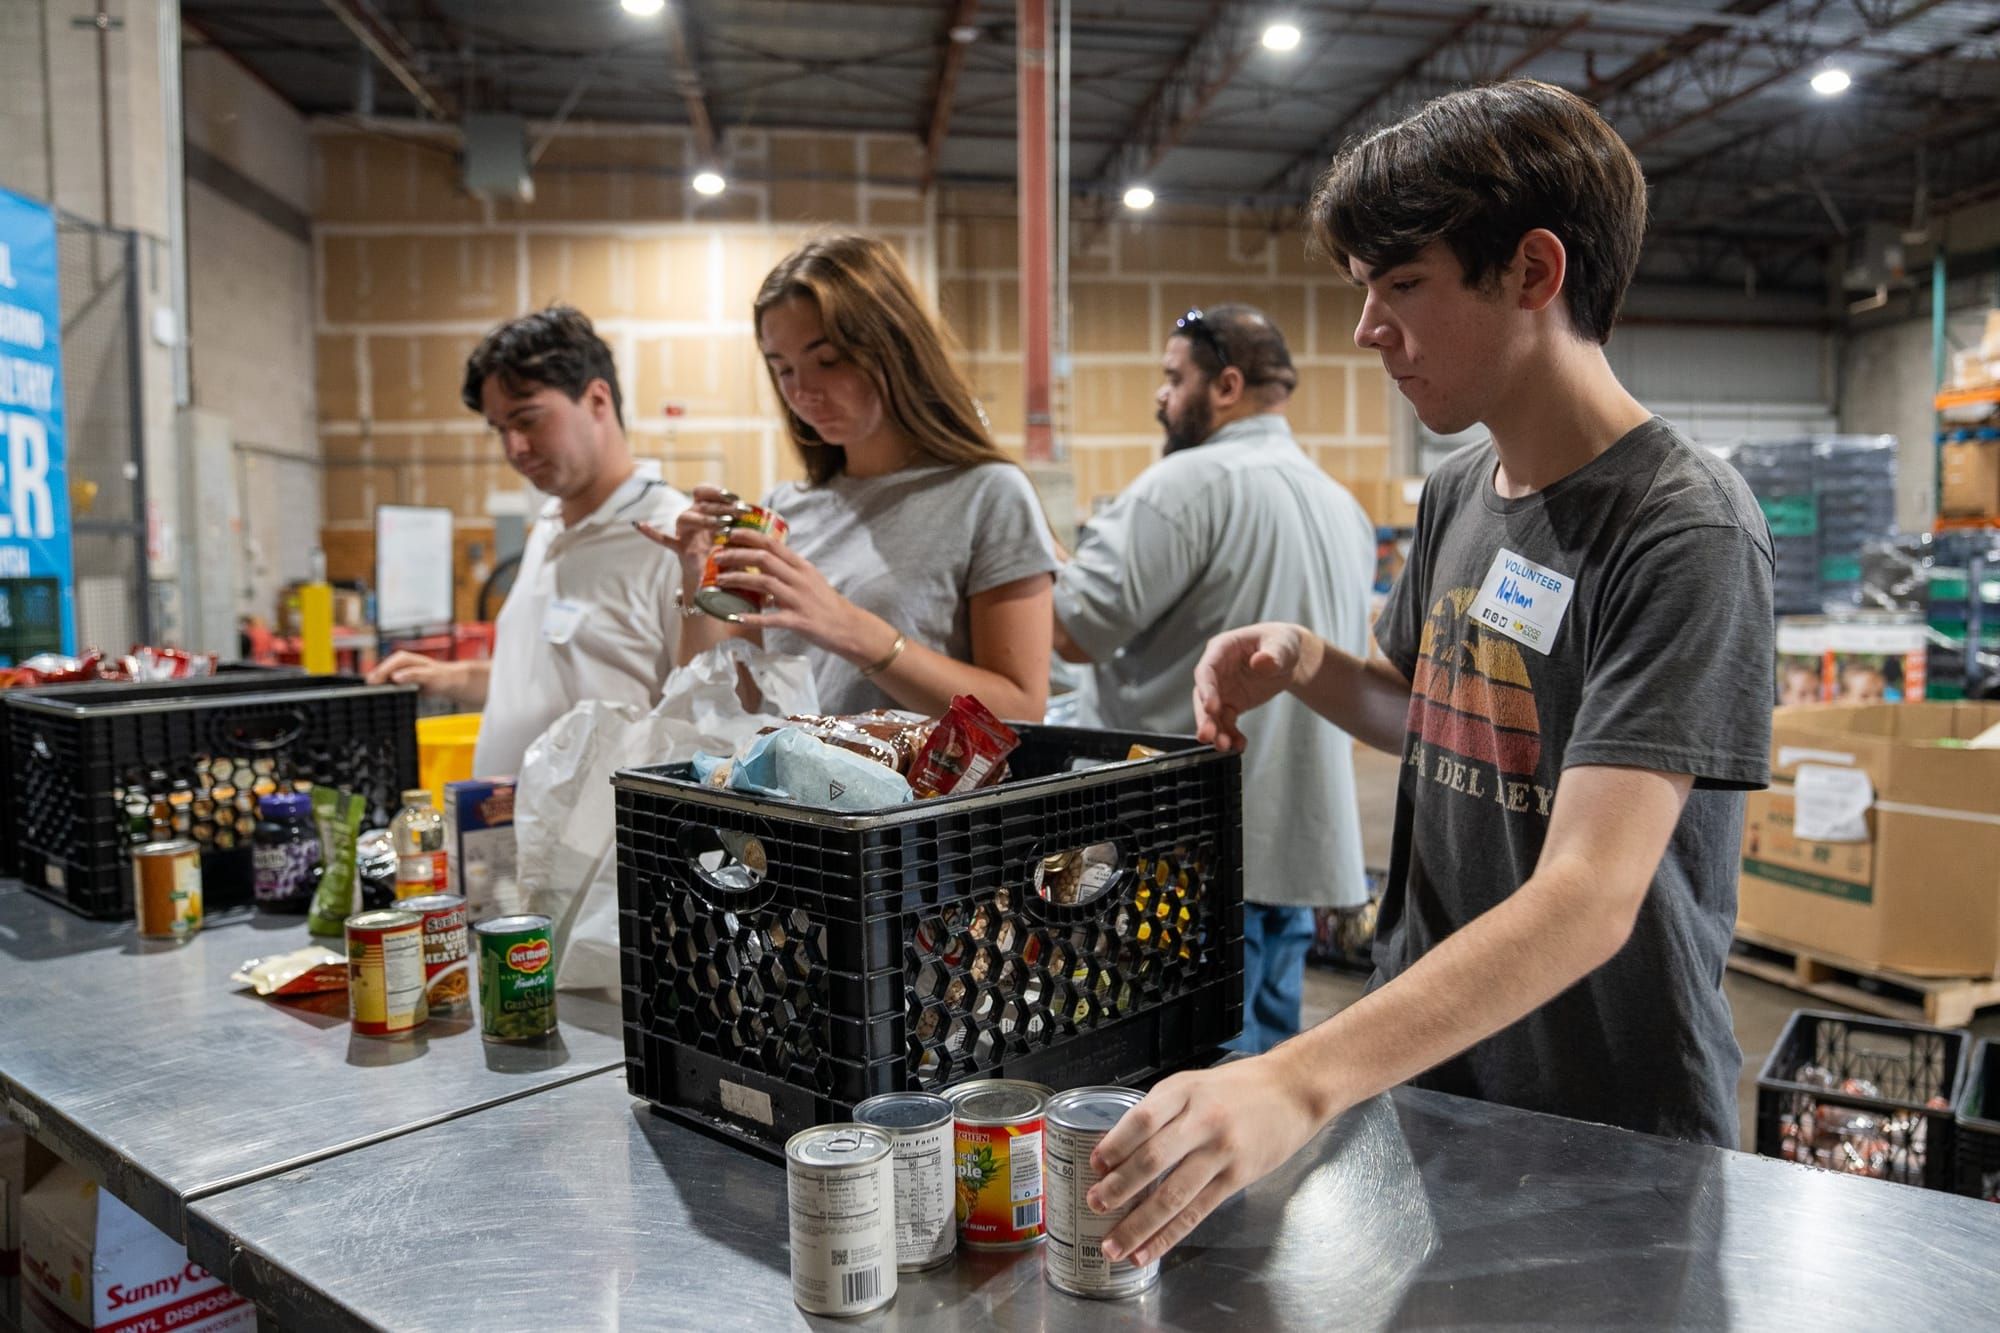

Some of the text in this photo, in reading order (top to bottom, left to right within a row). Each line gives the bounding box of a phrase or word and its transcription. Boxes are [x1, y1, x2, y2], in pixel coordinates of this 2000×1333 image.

[1505, 558, 1562, 593] VOLUNTEER
[1495, 576, 1534, 608] Nathan
[1401, 741, 1426, 777] A
[1434, 755, 1485, 798] DEL
[511, 952, 525, 963] Del
[915, 1135, 939, 1147] Facts
[1062, 1165, 1074, 1177] 60
[1081, 1245, 1103, 1258] 100%
